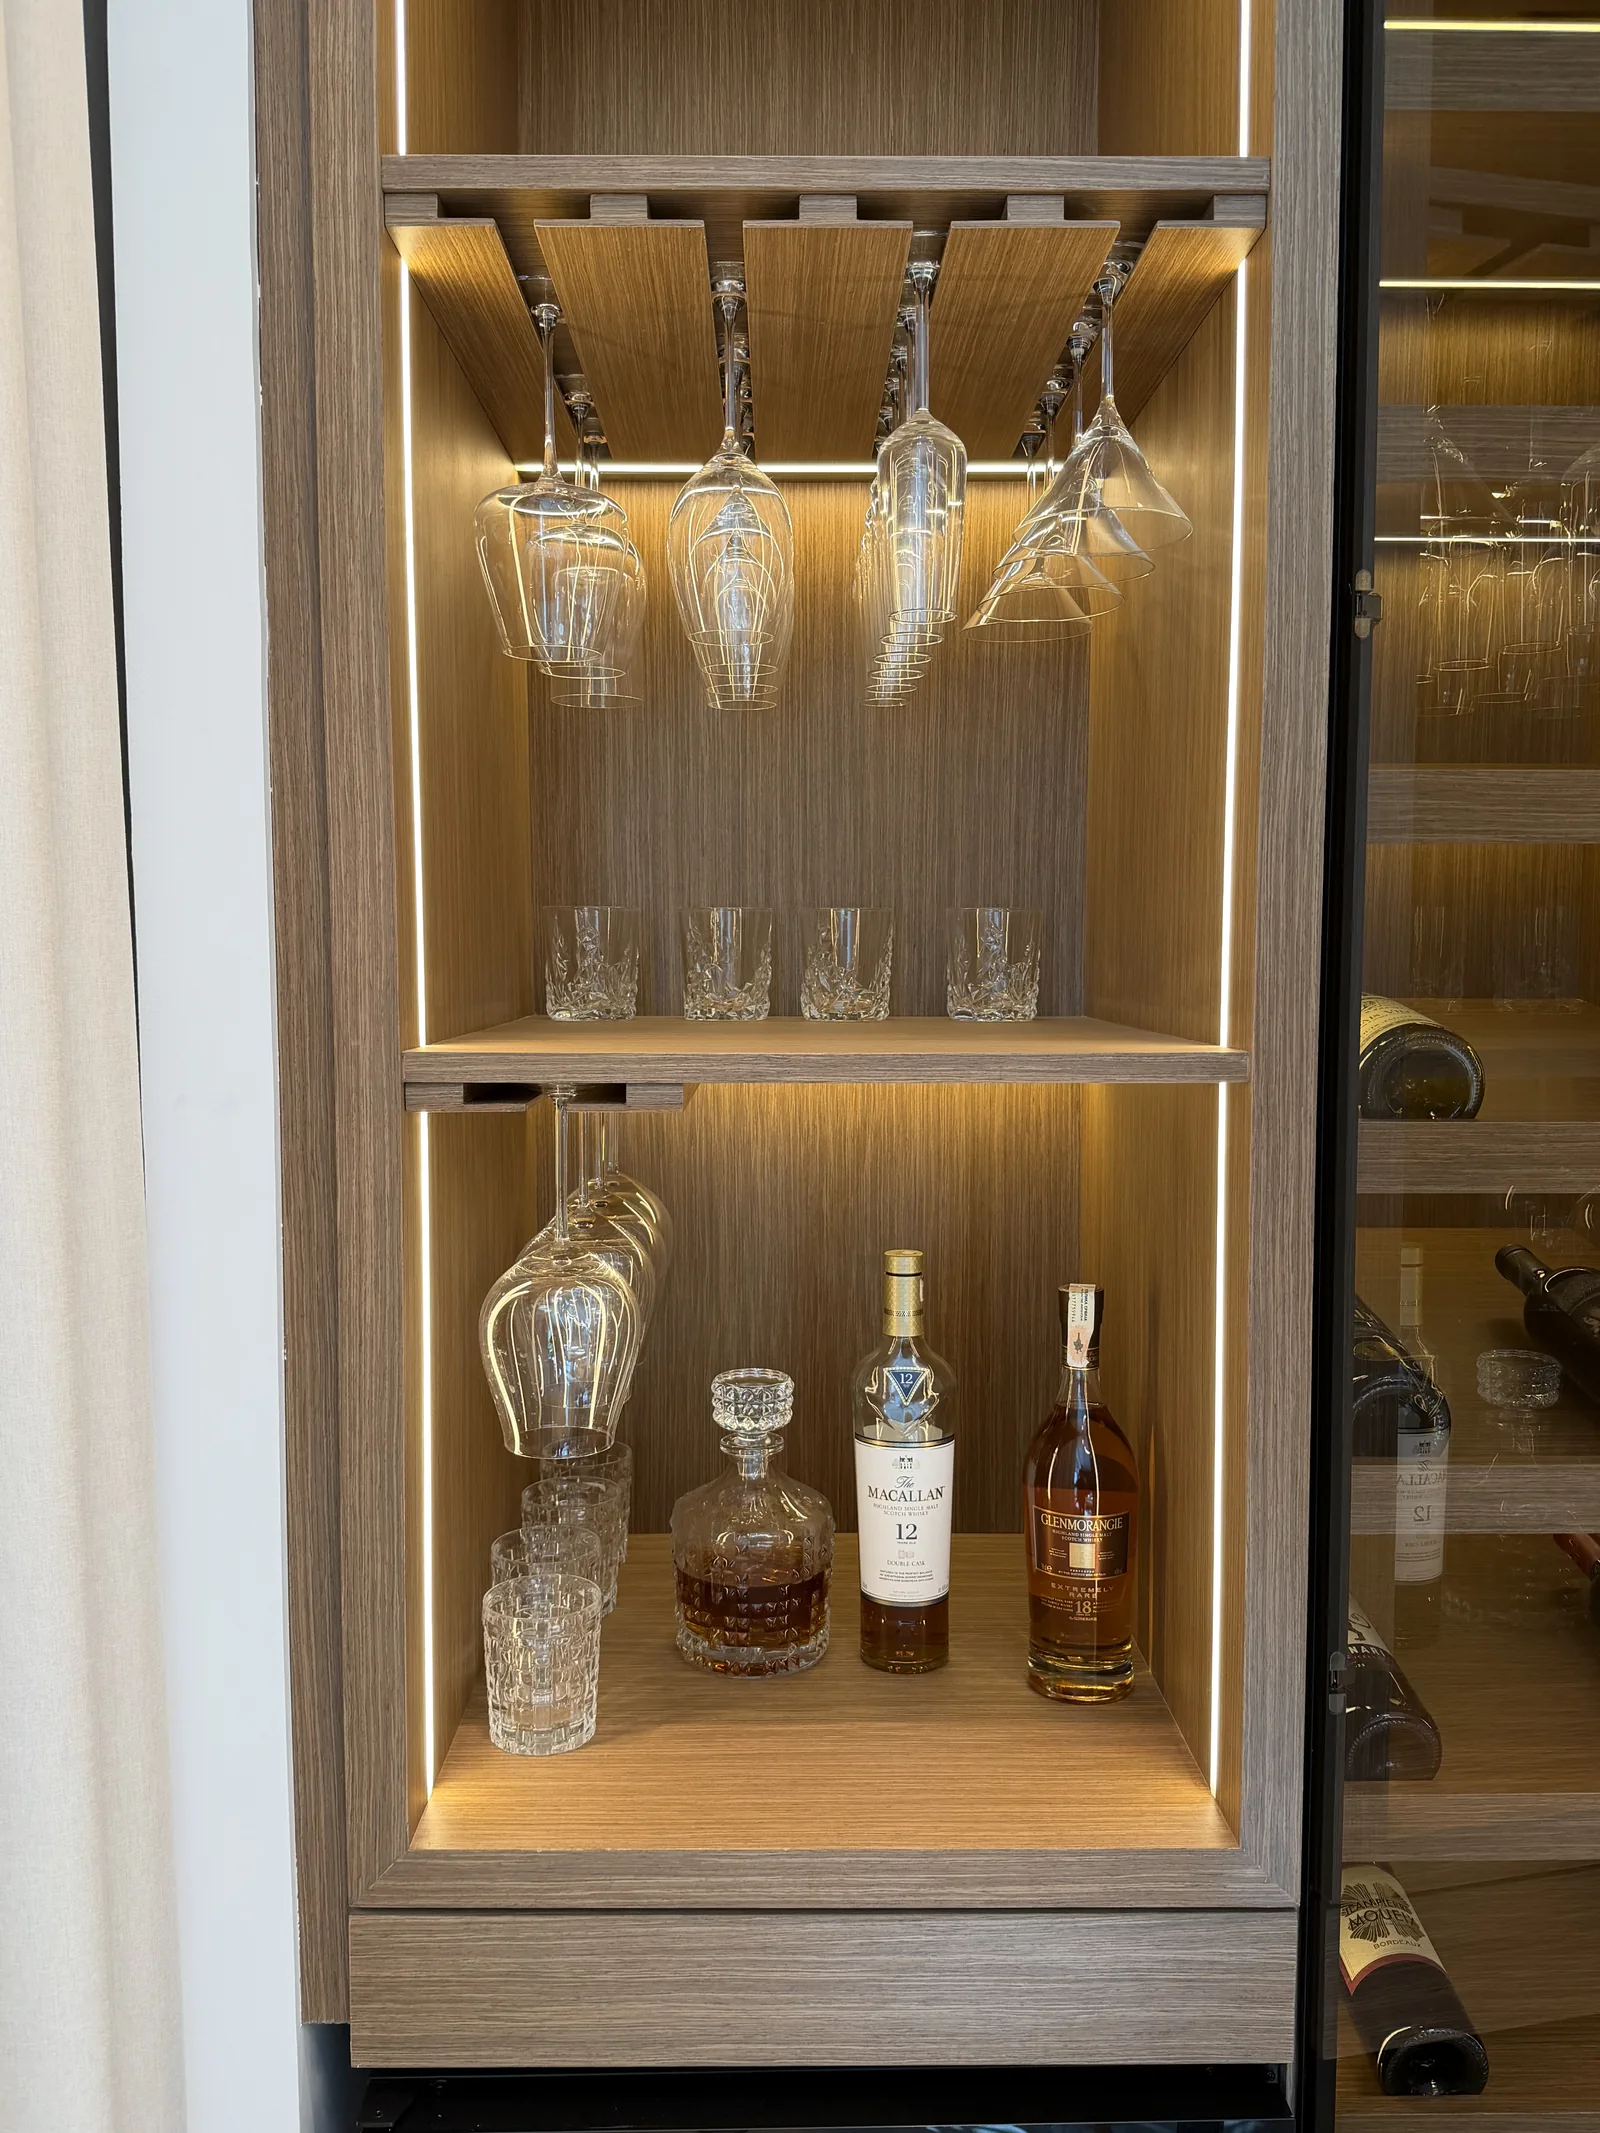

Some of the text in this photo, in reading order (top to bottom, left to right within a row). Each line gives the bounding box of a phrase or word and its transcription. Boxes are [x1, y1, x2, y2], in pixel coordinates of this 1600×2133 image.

[899, 1373, 913, 1384] 12
[894, 1475, 915, 1488] The
[867, 1485, 946, 1502] MACALLAN
[873, 1503, 902, 1511] HIGHLAND
[1040, 1513, 1123, 1532] GLENMORANGIE
[896, 1523, 918, 1540] 12
[1051, 1582, 1114, 1593] EXTREMELY
[1074, 1600, 1092, 1614] 18
[1348, 1908, 1415, 1931] MOUEIX
[1373, 1939, 1422, 1950] BORDEAUX
